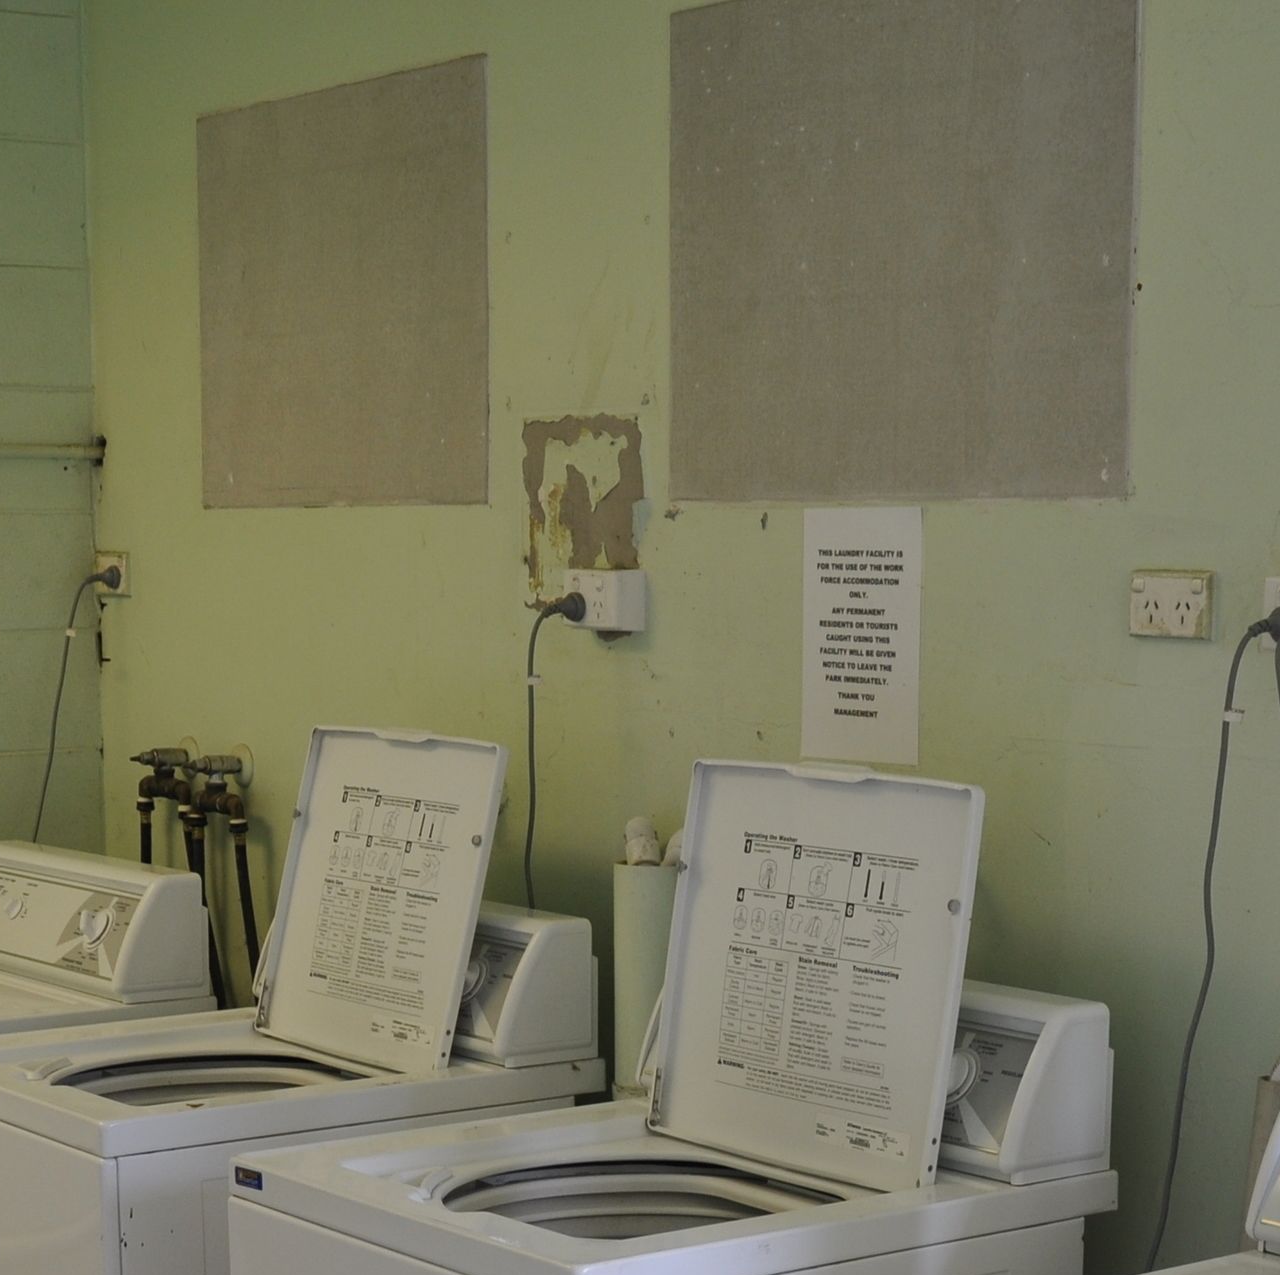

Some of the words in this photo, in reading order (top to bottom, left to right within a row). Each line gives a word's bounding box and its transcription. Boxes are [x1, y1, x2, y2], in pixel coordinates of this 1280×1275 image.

[842, 577, 899, 585] ACCOMMODATION
[819, 620, 853, 628] RESIDENTS
[866, 622, 897, 630] TOURISTS
[849, 648, 863, 656] WILL
[844, 676, 888, 685] IMMEDIATELY.
[837, 691, 858, 699] THANK
[833, 708, 878, 717] MANAGEMENT
